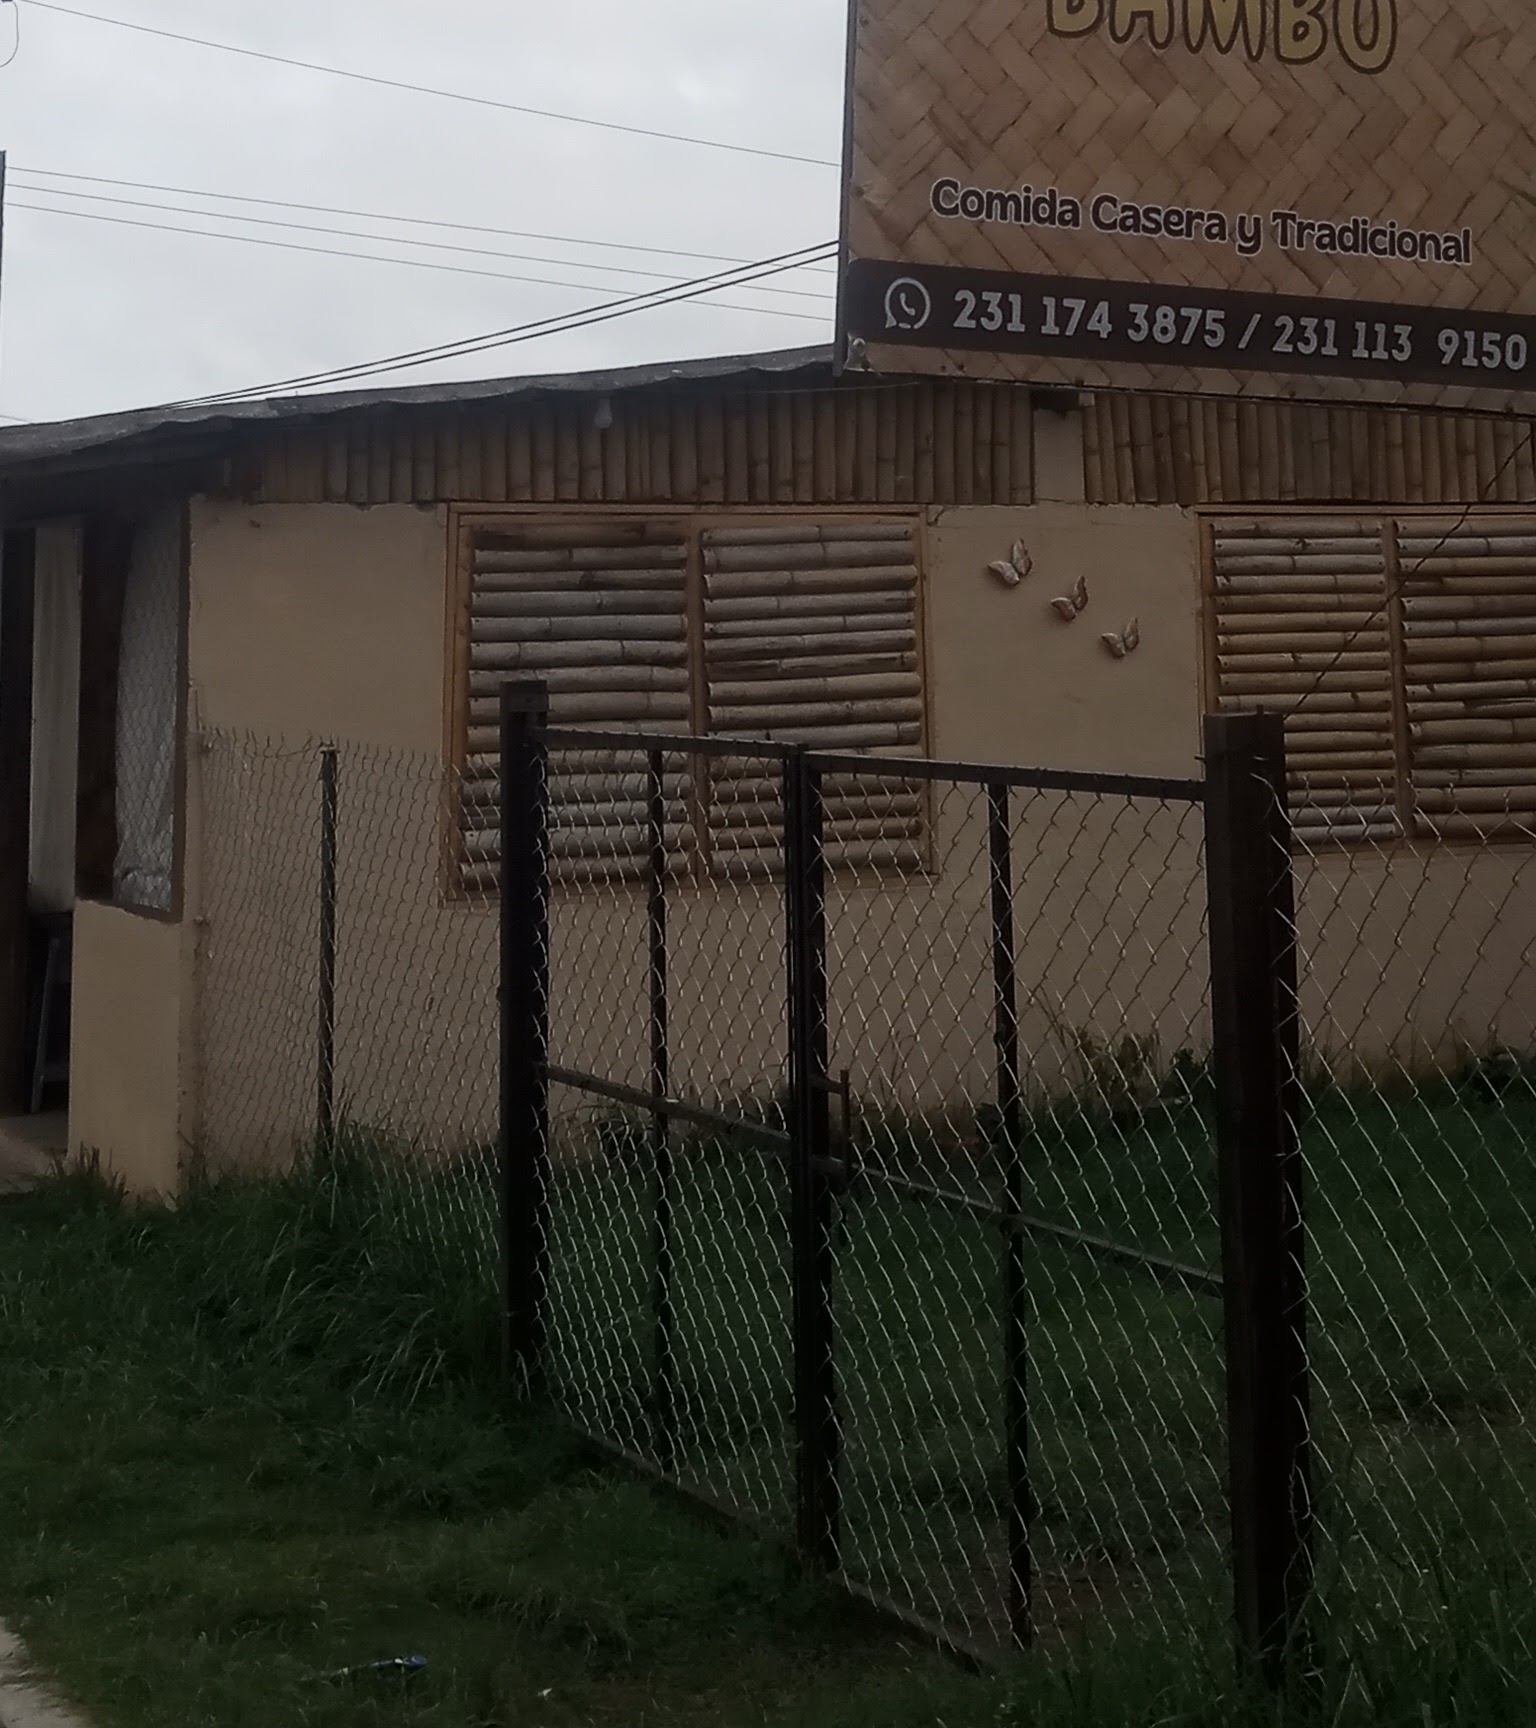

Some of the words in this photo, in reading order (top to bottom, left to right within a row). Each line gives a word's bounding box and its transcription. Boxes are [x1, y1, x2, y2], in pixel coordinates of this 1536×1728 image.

[930, 177, 1080, 229] Comida
[1090, 193, 1227, 243] Casera
[1235, 214, 1262, 255] y
[1271, 210, 1472, 264] Tradicional
[953, 289, 1025, 333] 231
[1040, 296, 1113, 339] 174
[1126, 302, 1226, 348] 3875
[1237, 312, 1261, 349] /
[1272, 316, 1338, 356] 231
[1351, 320, 1412, 362] 113
[1436, 327, 1528, 371] 9150
